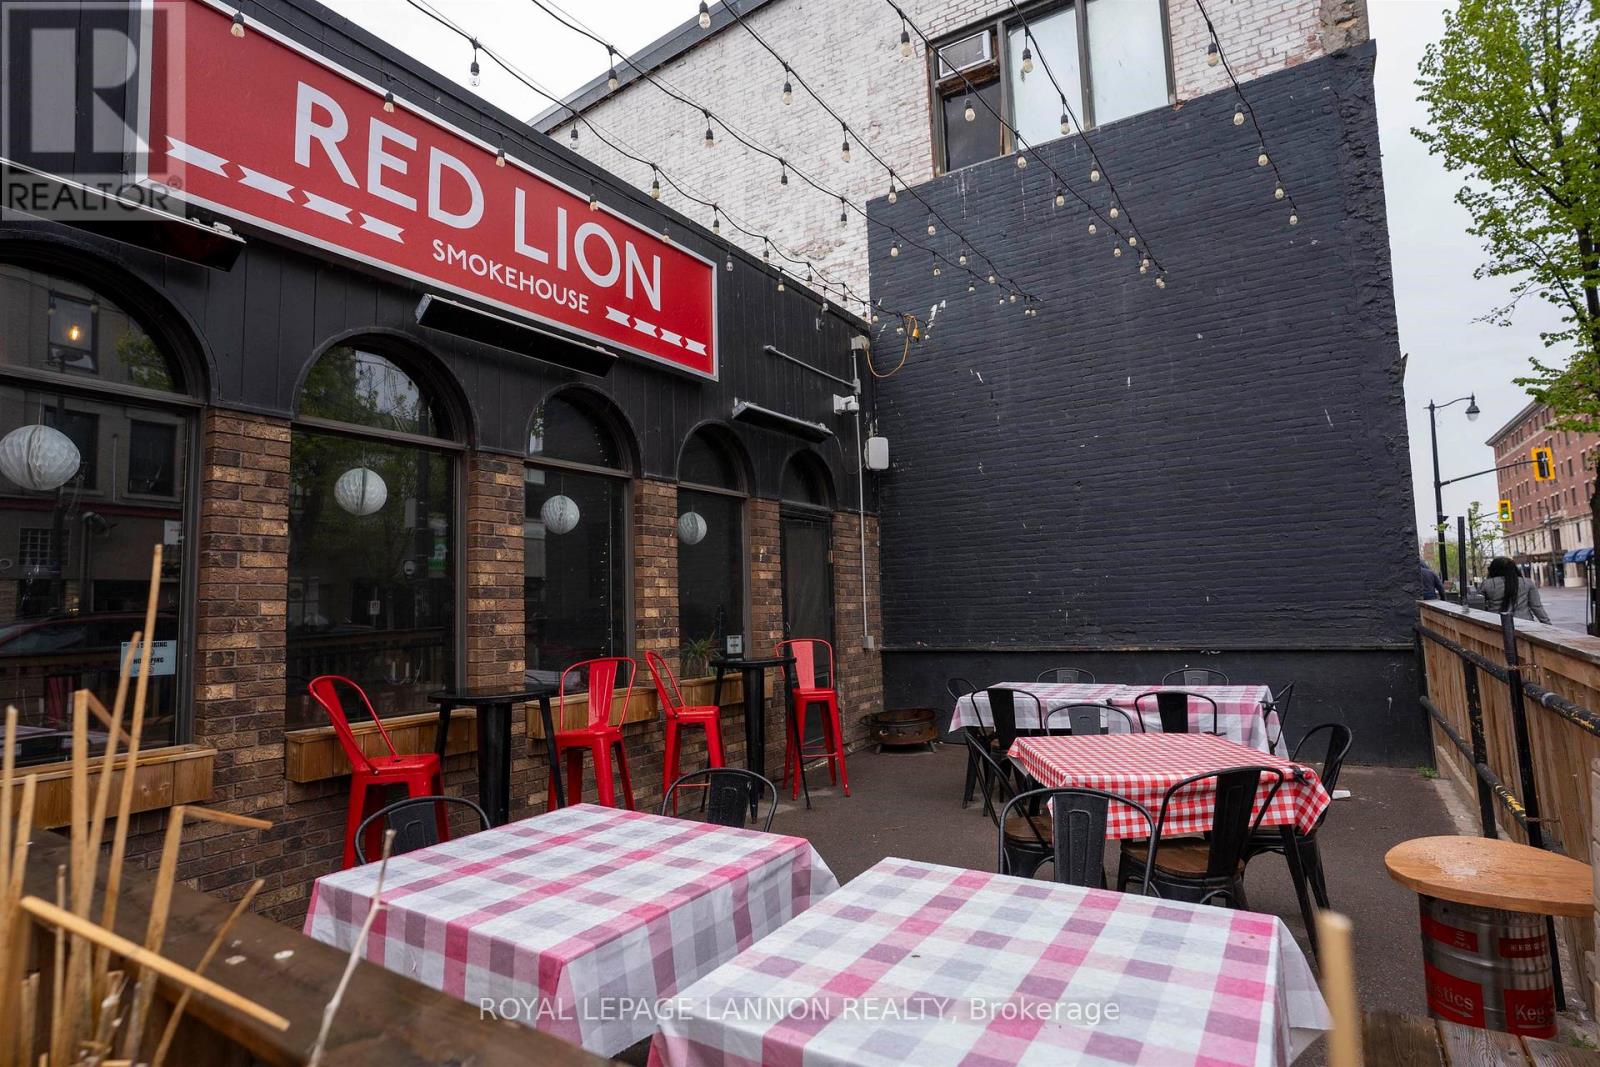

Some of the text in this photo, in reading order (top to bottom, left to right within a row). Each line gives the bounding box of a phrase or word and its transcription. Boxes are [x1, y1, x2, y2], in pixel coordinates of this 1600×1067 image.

[295, 81, 661, 312] RED LION
[432, 239, 589, 314] SMOKEHOUSE
